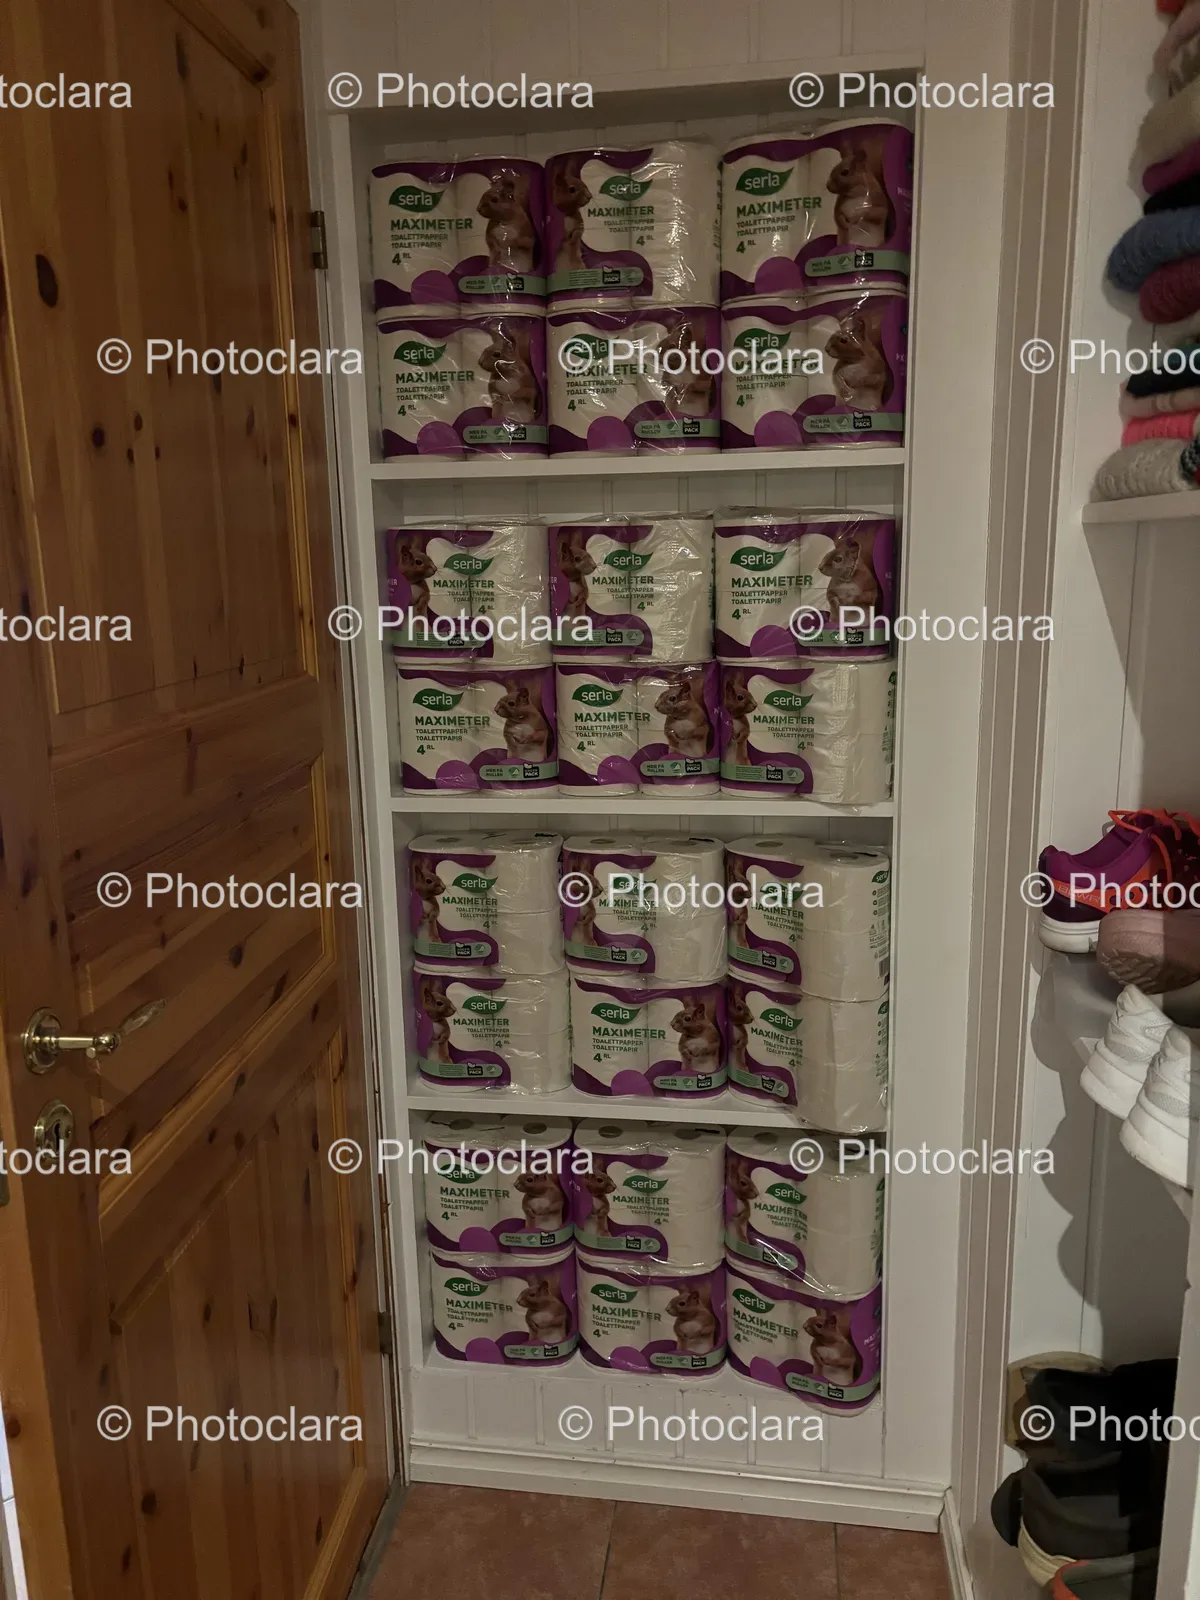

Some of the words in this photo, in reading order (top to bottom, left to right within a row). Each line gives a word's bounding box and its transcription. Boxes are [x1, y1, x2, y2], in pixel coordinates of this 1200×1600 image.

[744, 173, 780, 190] serla
[610, 183, 640, 194] serla
[398, 193, 432, 205] serla
[588, 206, 654, 217] MAXIMETER
[737, 197, 822, 218] MAXIMETER
[391, 218, 472, 230] MAXIMETER
[737, 216, 795, 228] TOALETTPAPPER
[737, 225, 789, 236] TOALETTPAPIR
[636, 236, 645, 245] 4
[736, 241, 745, 253] 4
[392, 253, 401, 265] 4
[744, 334, 779, 347] serla
[403, 348, 434, 360] serla
[396, 371, 474, 383] MAXIMETER
[568, 400, 576, 411] 4
[736, 395, 744, 407] 4
[398, 405, 406, 416] 4
[453, 559, 482, 569] serla
[613, 555, 642, 565] serla
[740, 553, 774, 565] serla
[433, 580, 494, 588] MAXIMETER
[592, 576, 654, 584] MAXIMETER
[732, 575, 812, 588] MAXIMETER
[478, 605, 486, 614] 4
[637, 602, 645, 610] 4
[732, 609, 741, 619] 4
[422, 694, 452, 705] serla
[581, 690, 613, 701] serla
[773, 696, 801, 706] serla
[415, 716, 490, 726] MAXIMETER
[574, 712, 650, 722] MAXIMETER
[753, 715, 814, 724] MAXIMETER
[417, 745, 425, 754] 4
[577, 741, 586, 751] 4
[797, 742, 806, 750] 4
[461, 878, 487, 888] serla
[443, 897, 497, 905] MAXIMETER
[641, 924, 648, 932] 4
[789, 934, 796, 942] 4
[471, 1001, 497, 1010] serla
[600, 1008, 629, 1019] serla
[768, 1013, 794, 1027] serla
[592, 1026, 665, 1039] MAXIMETER
[751, 1027, 803, 1045] MAXIMETER
[592, 1038, 643, 1046] TOALETTPAPPER
[594, 1053, 602, 1062] 4
[632, 1180, 658, 1189] serla
[440, 1187, 509, 1198] MAXIMETER
[775, 1188, 800, 1200] serla
[613, 1196, 669, 1204] MAXIMETER
[442, 1212, 449, 1220] 4
[754, 1202, 808, 1220] MAXIMETER
[452, 1282, 480, 1292] serla
[599, 1289, 627, 1300] serla
[446, 1298, 512, 1312] MAXIMETER
[739, 1294, 765, 1310] serla
[592, 1304, 661, 1321] MAXIMETER
[734, 1308, 798, 1338] MAXIMETER
[593, 1329, 600, 1337] 4
[734, 1333, 741, 1342] 4
